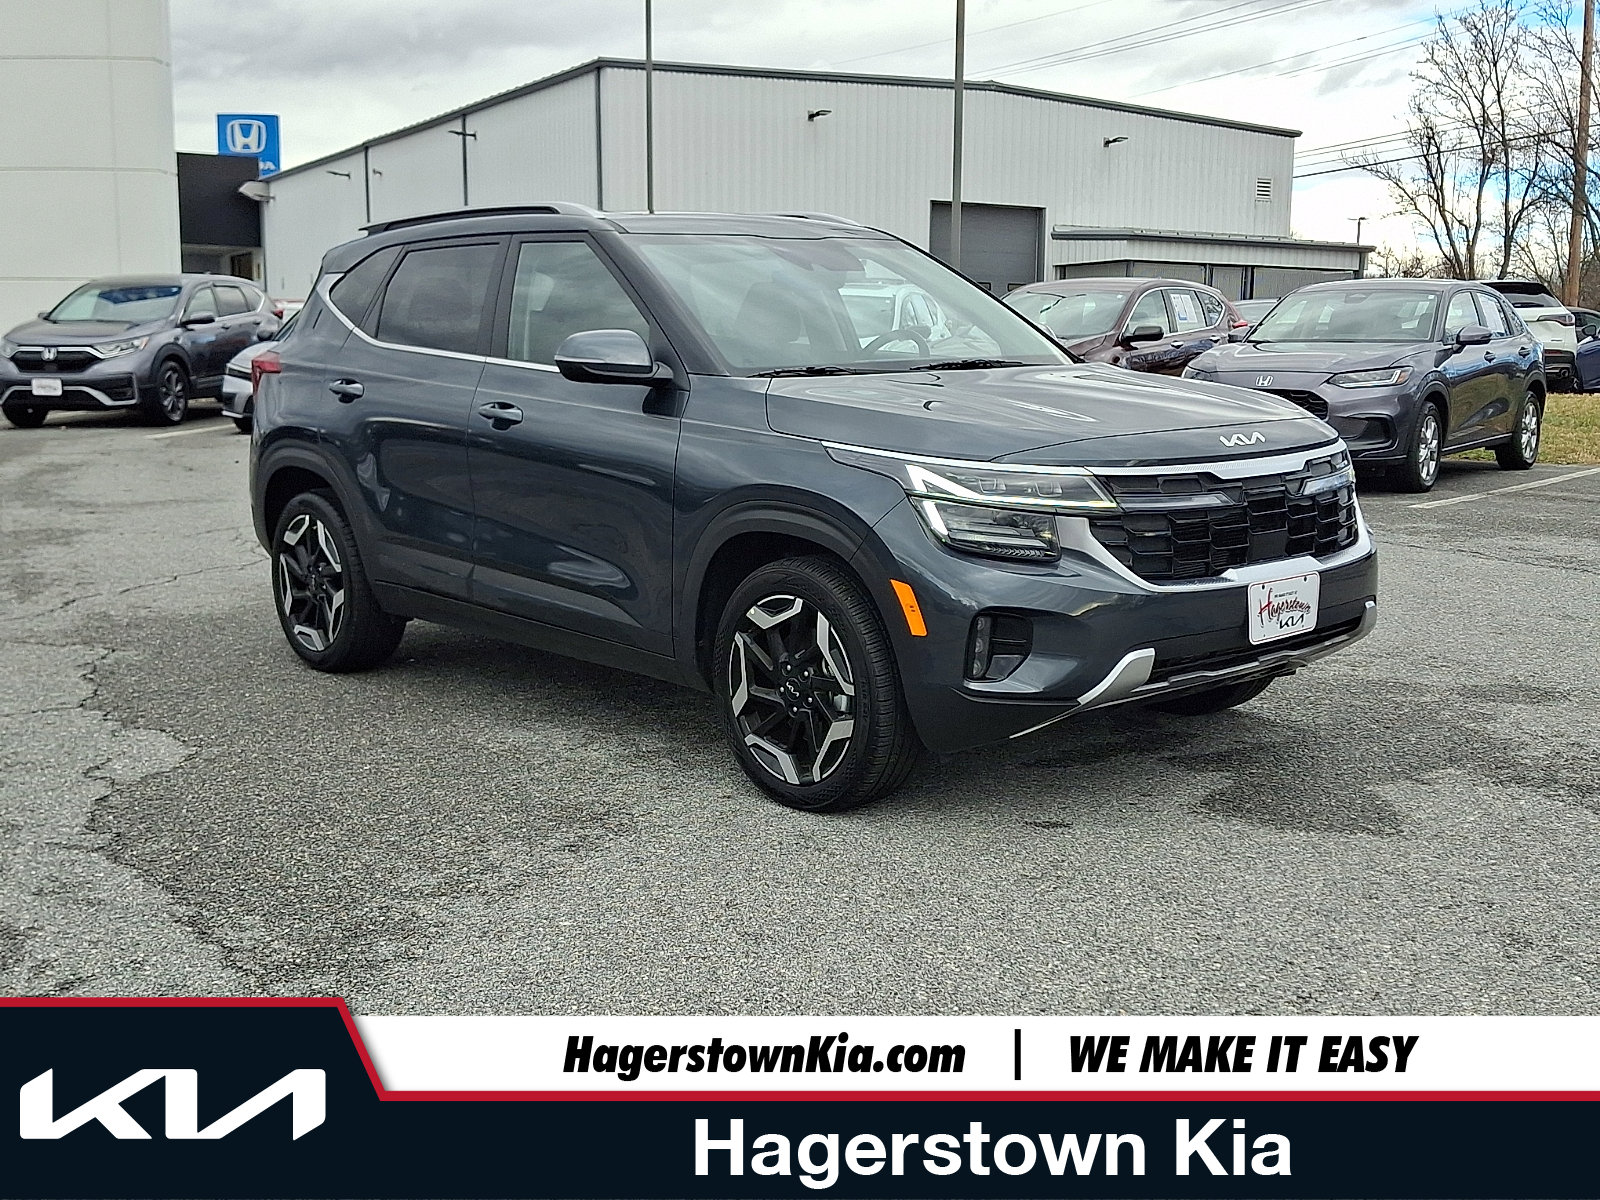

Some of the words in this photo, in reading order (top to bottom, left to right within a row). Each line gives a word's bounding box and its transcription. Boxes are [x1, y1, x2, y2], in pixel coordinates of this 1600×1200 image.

[1219, 431, 1266, 447] KIA
[1257, 588, 1311, 628] Hagerstown
[1279, 613, 1304, 629] KIA
